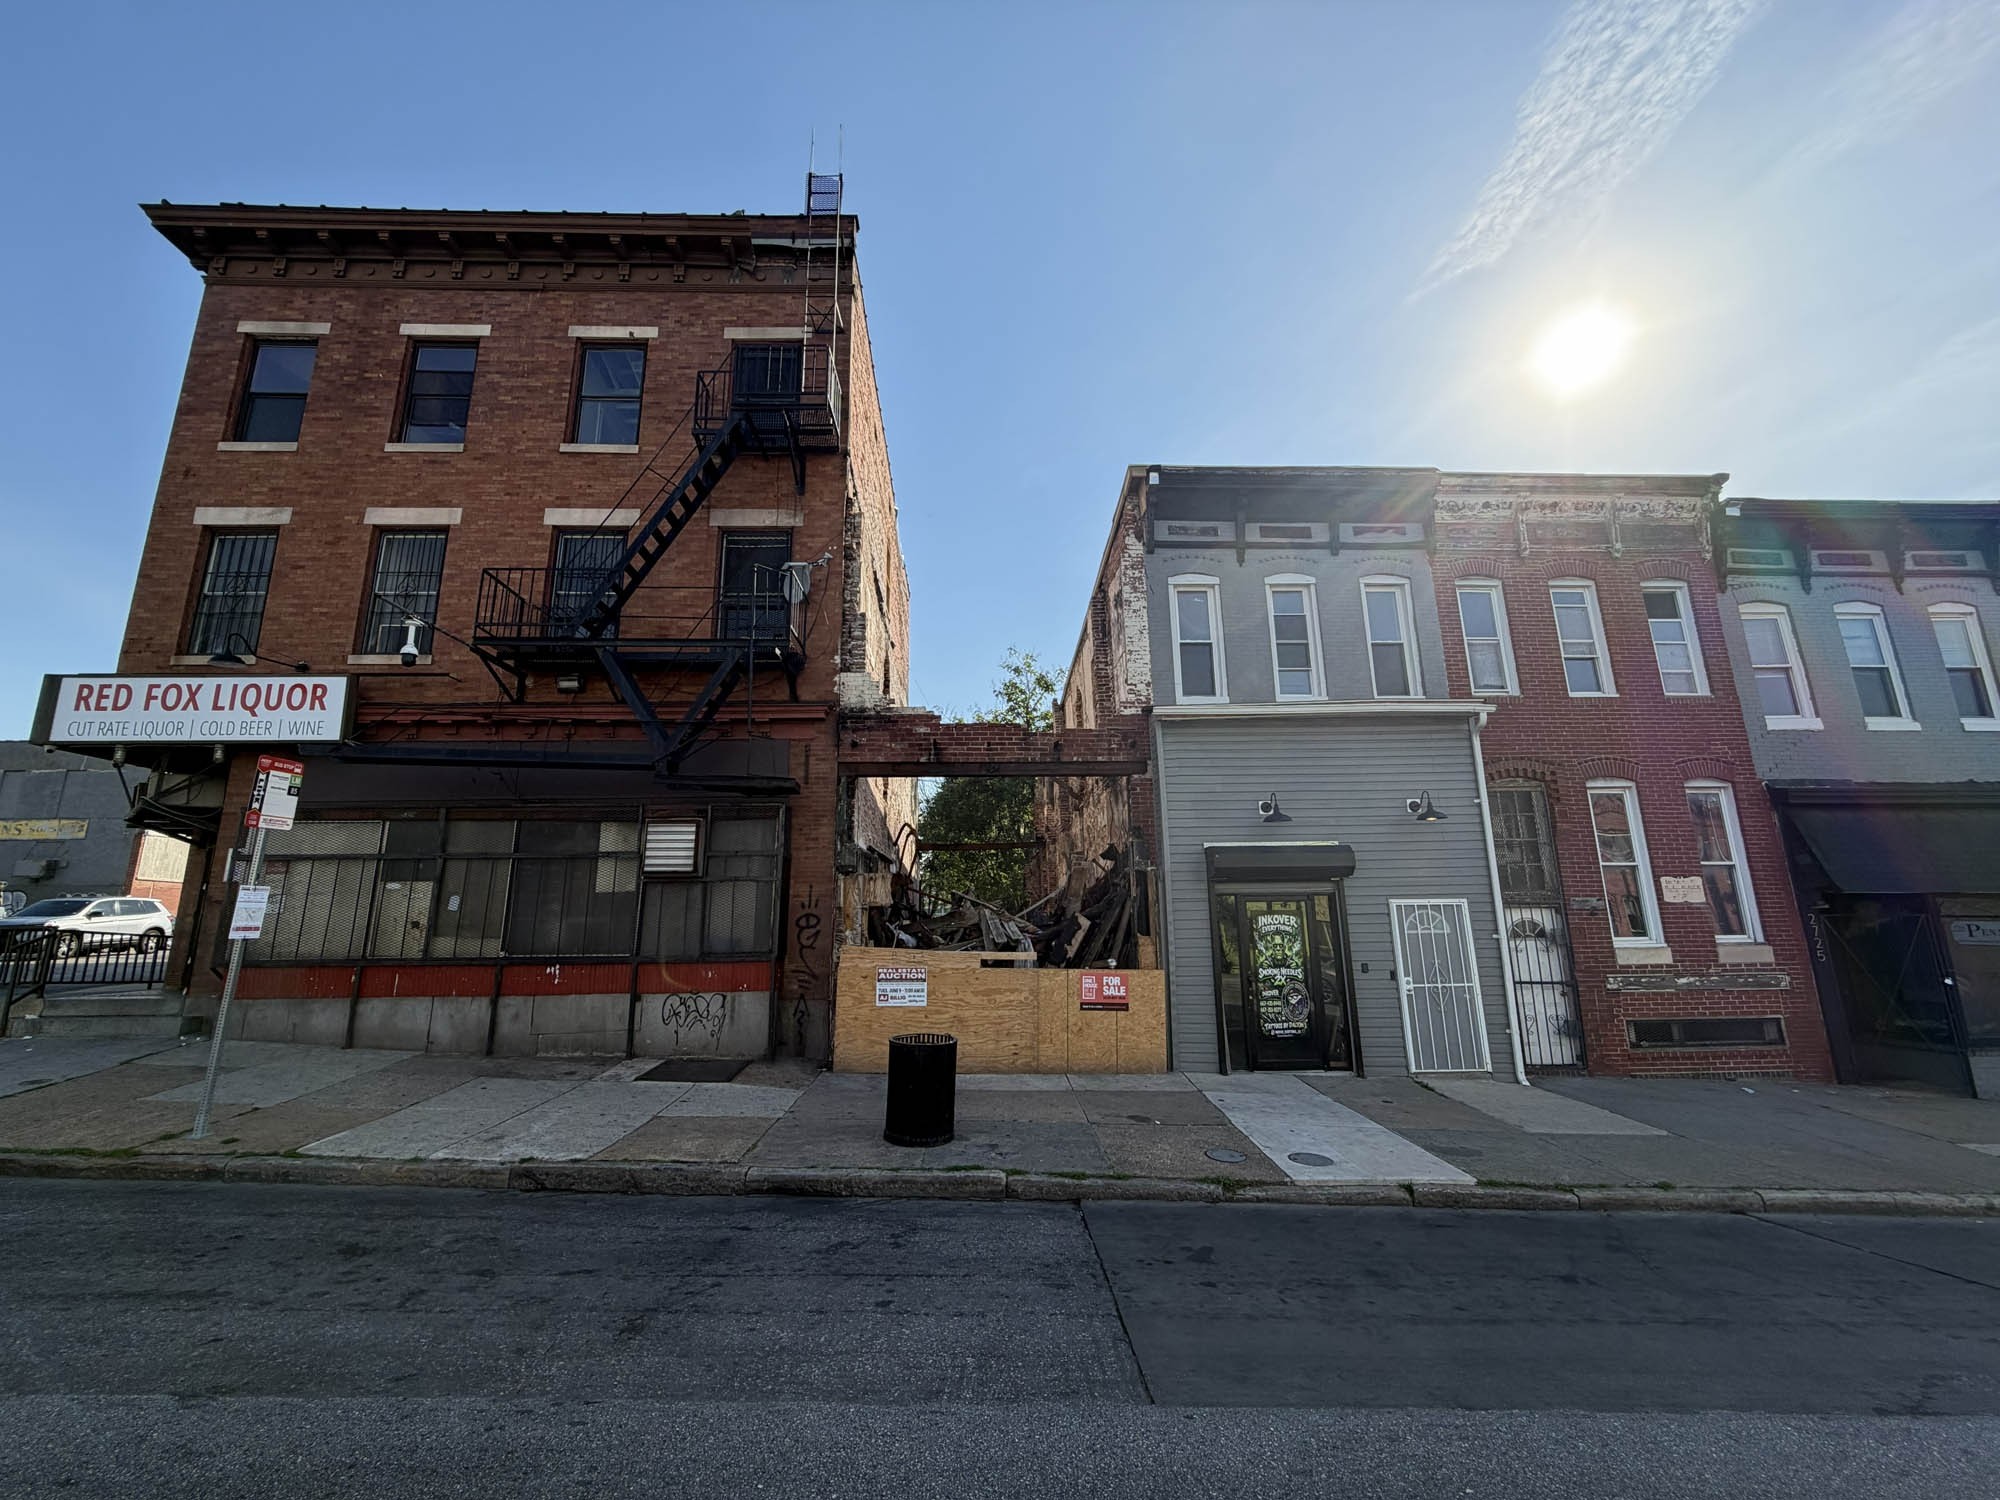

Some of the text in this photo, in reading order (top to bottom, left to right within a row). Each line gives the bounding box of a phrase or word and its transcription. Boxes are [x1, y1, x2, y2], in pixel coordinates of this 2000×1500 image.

[74, 683, 328, 717] RED FOX LIQUOR
[67, 720, 325, 738] CUT RATE LIQUOR COLD BEER WINE
[1258, 914, 1297, 928] INKOVER
[1807, 913, 1826, 962] 2725
[1103, 976, 1121, 986] FOR
[1103, 986, 1126, 996] SALE
